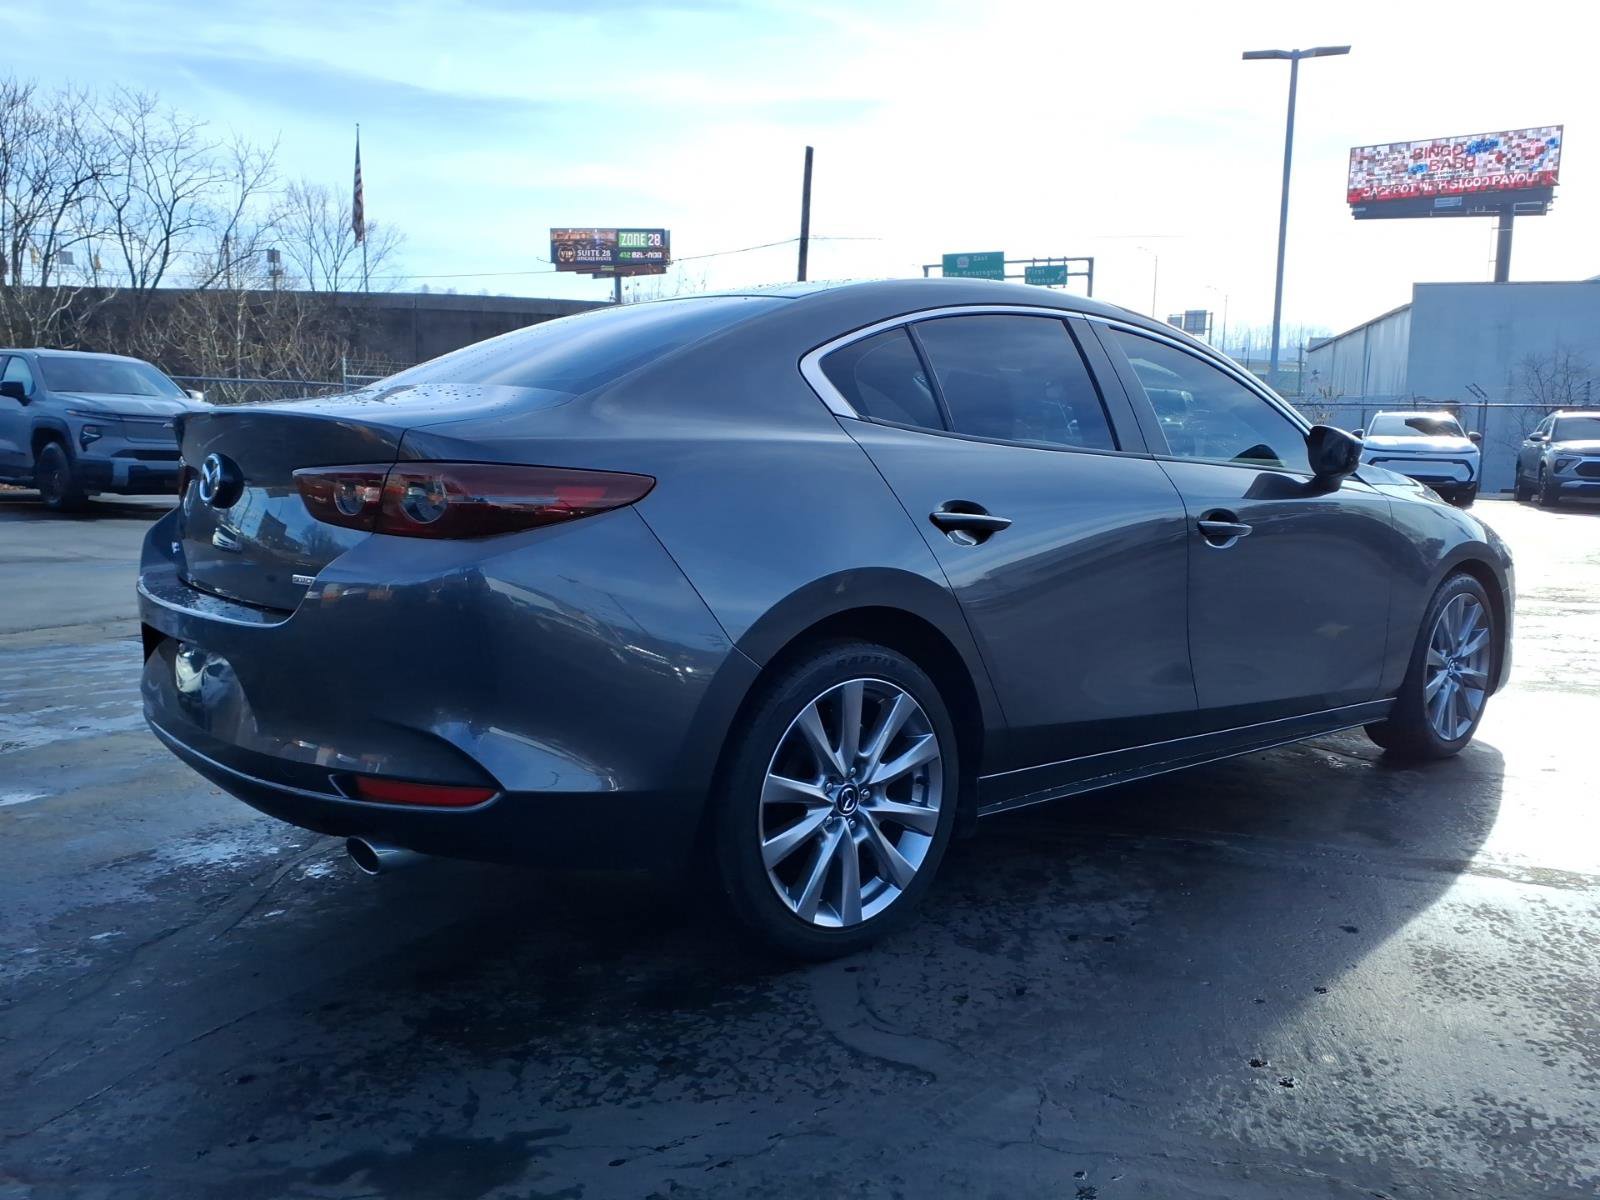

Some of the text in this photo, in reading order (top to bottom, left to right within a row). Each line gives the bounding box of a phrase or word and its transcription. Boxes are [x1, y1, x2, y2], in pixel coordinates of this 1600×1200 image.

[1411, 143, 1464, 160] BINGO
[1362, 183, 1417, 197] JACKPOT
[1491, 172, 1540, 186] PAYOUT
[620, 233, 646, 246] ZONE
[647, 233, 661, 246] 28
[577, 249, 611, 257] SUITE 28
